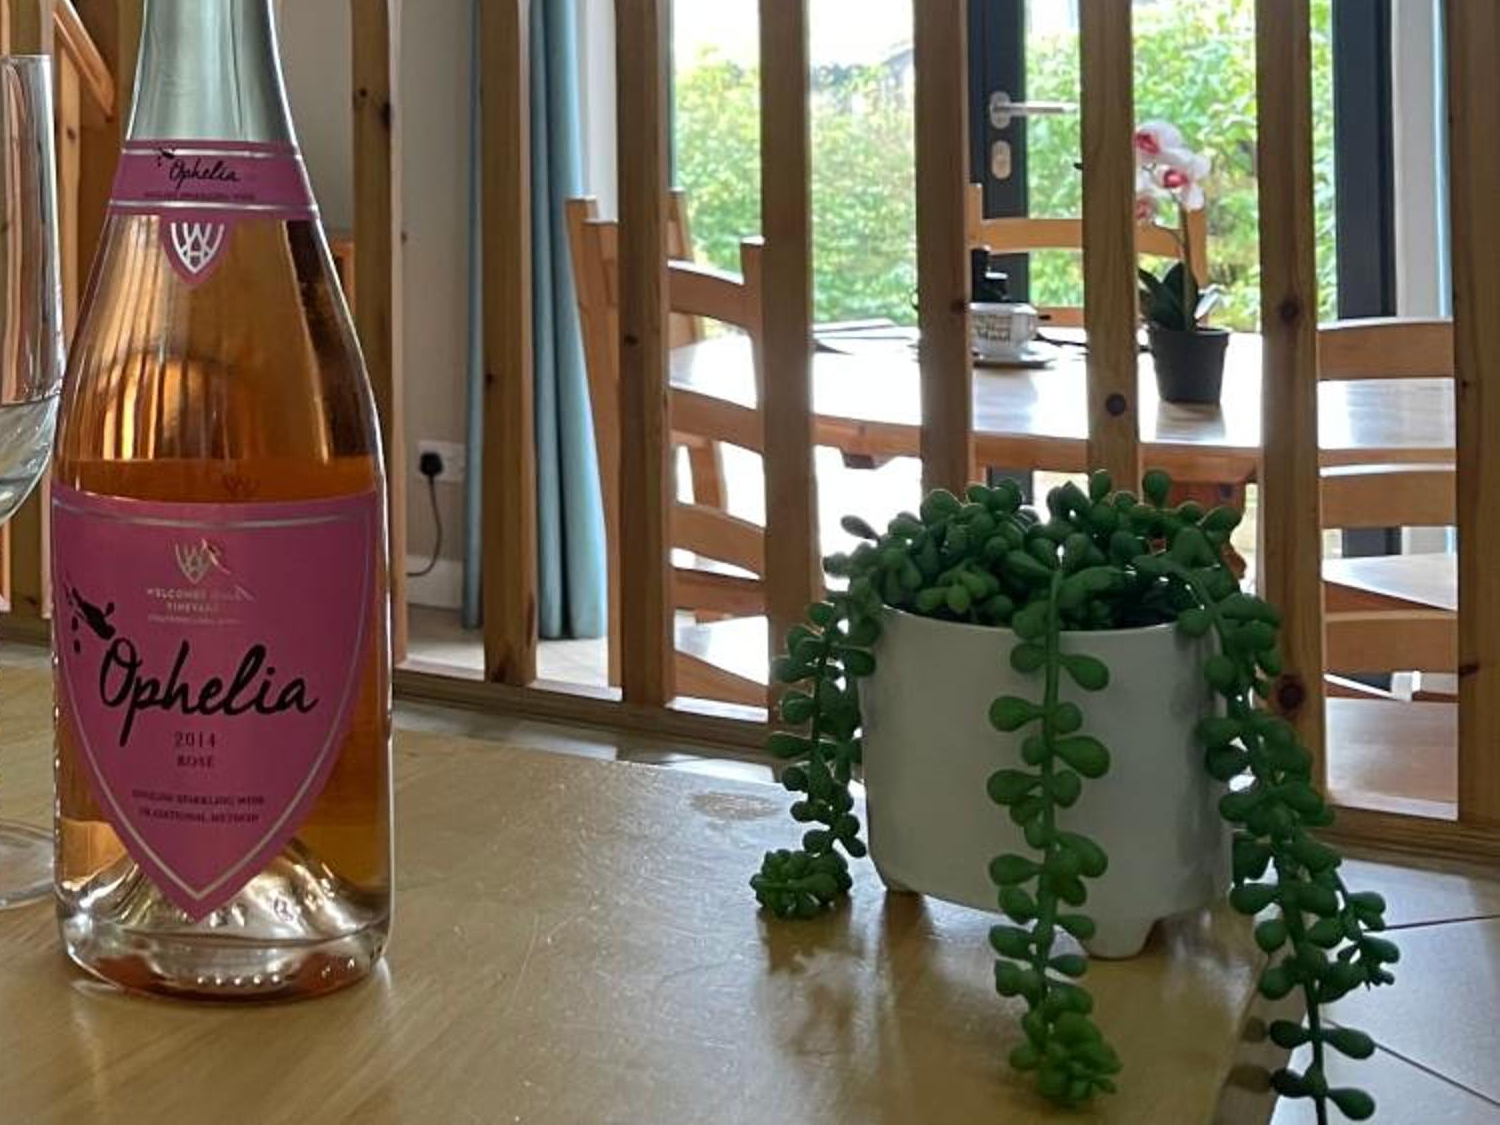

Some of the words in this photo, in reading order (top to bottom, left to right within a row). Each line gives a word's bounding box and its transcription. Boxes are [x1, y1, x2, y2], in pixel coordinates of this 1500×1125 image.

[169, 159, 241, 191] Ophelia
[100, 637, 319, 747] Ophelia
[174, 730, 216, 748] 2014
